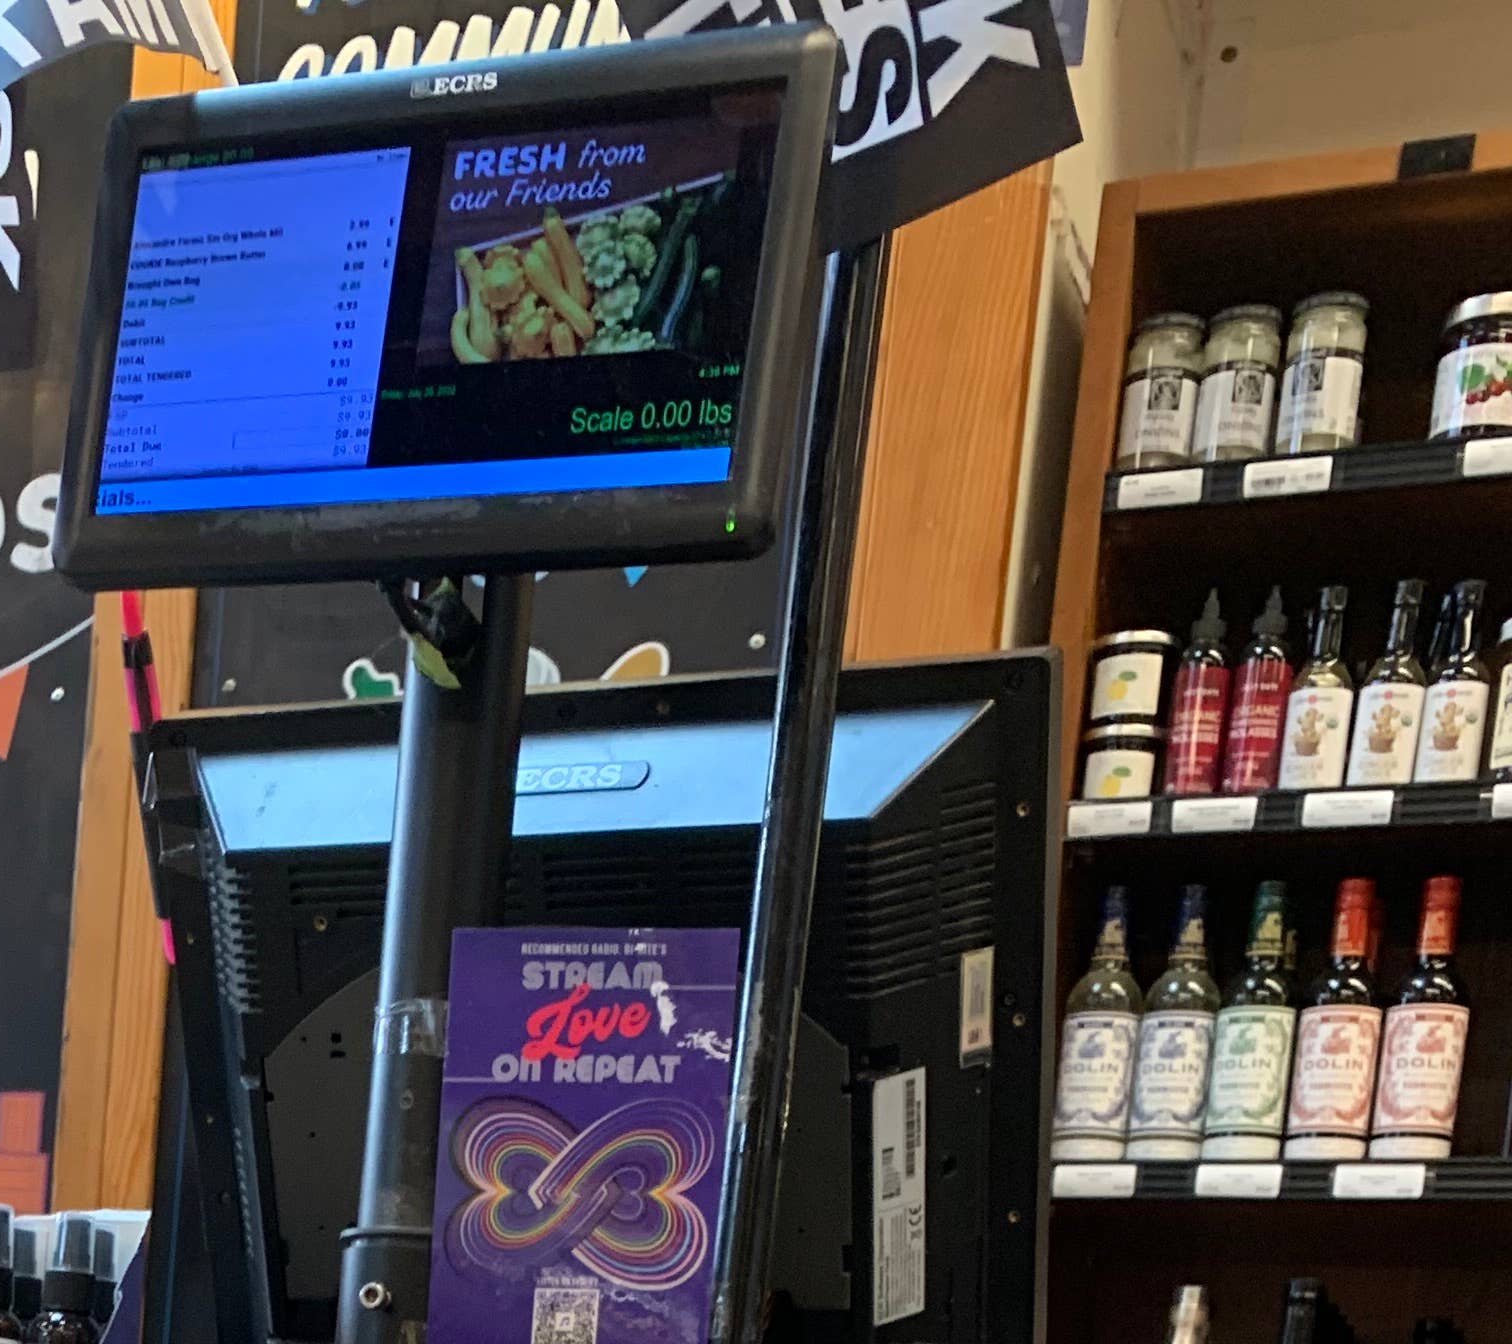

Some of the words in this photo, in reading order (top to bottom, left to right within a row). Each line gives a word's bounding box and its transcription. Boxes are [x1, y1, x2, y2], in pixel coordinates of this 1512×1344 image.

[434, 72, 498, 95] ECRS
[454, 144, 567, 180] FRESH
[577, 139, 647, 169] from
[449, 188, 497, 212] our
[504, 175, 613, 209] Friends
[570, 406, 634, 434] Scale
[641, 400, 692, 429] 0.00
[699, 398, 732, 425] lbs
[521, 961, 664, 991] STREAM
[519, 982, 652, 1062] Love
[554, 1054, 682, 1084] REPEAT
